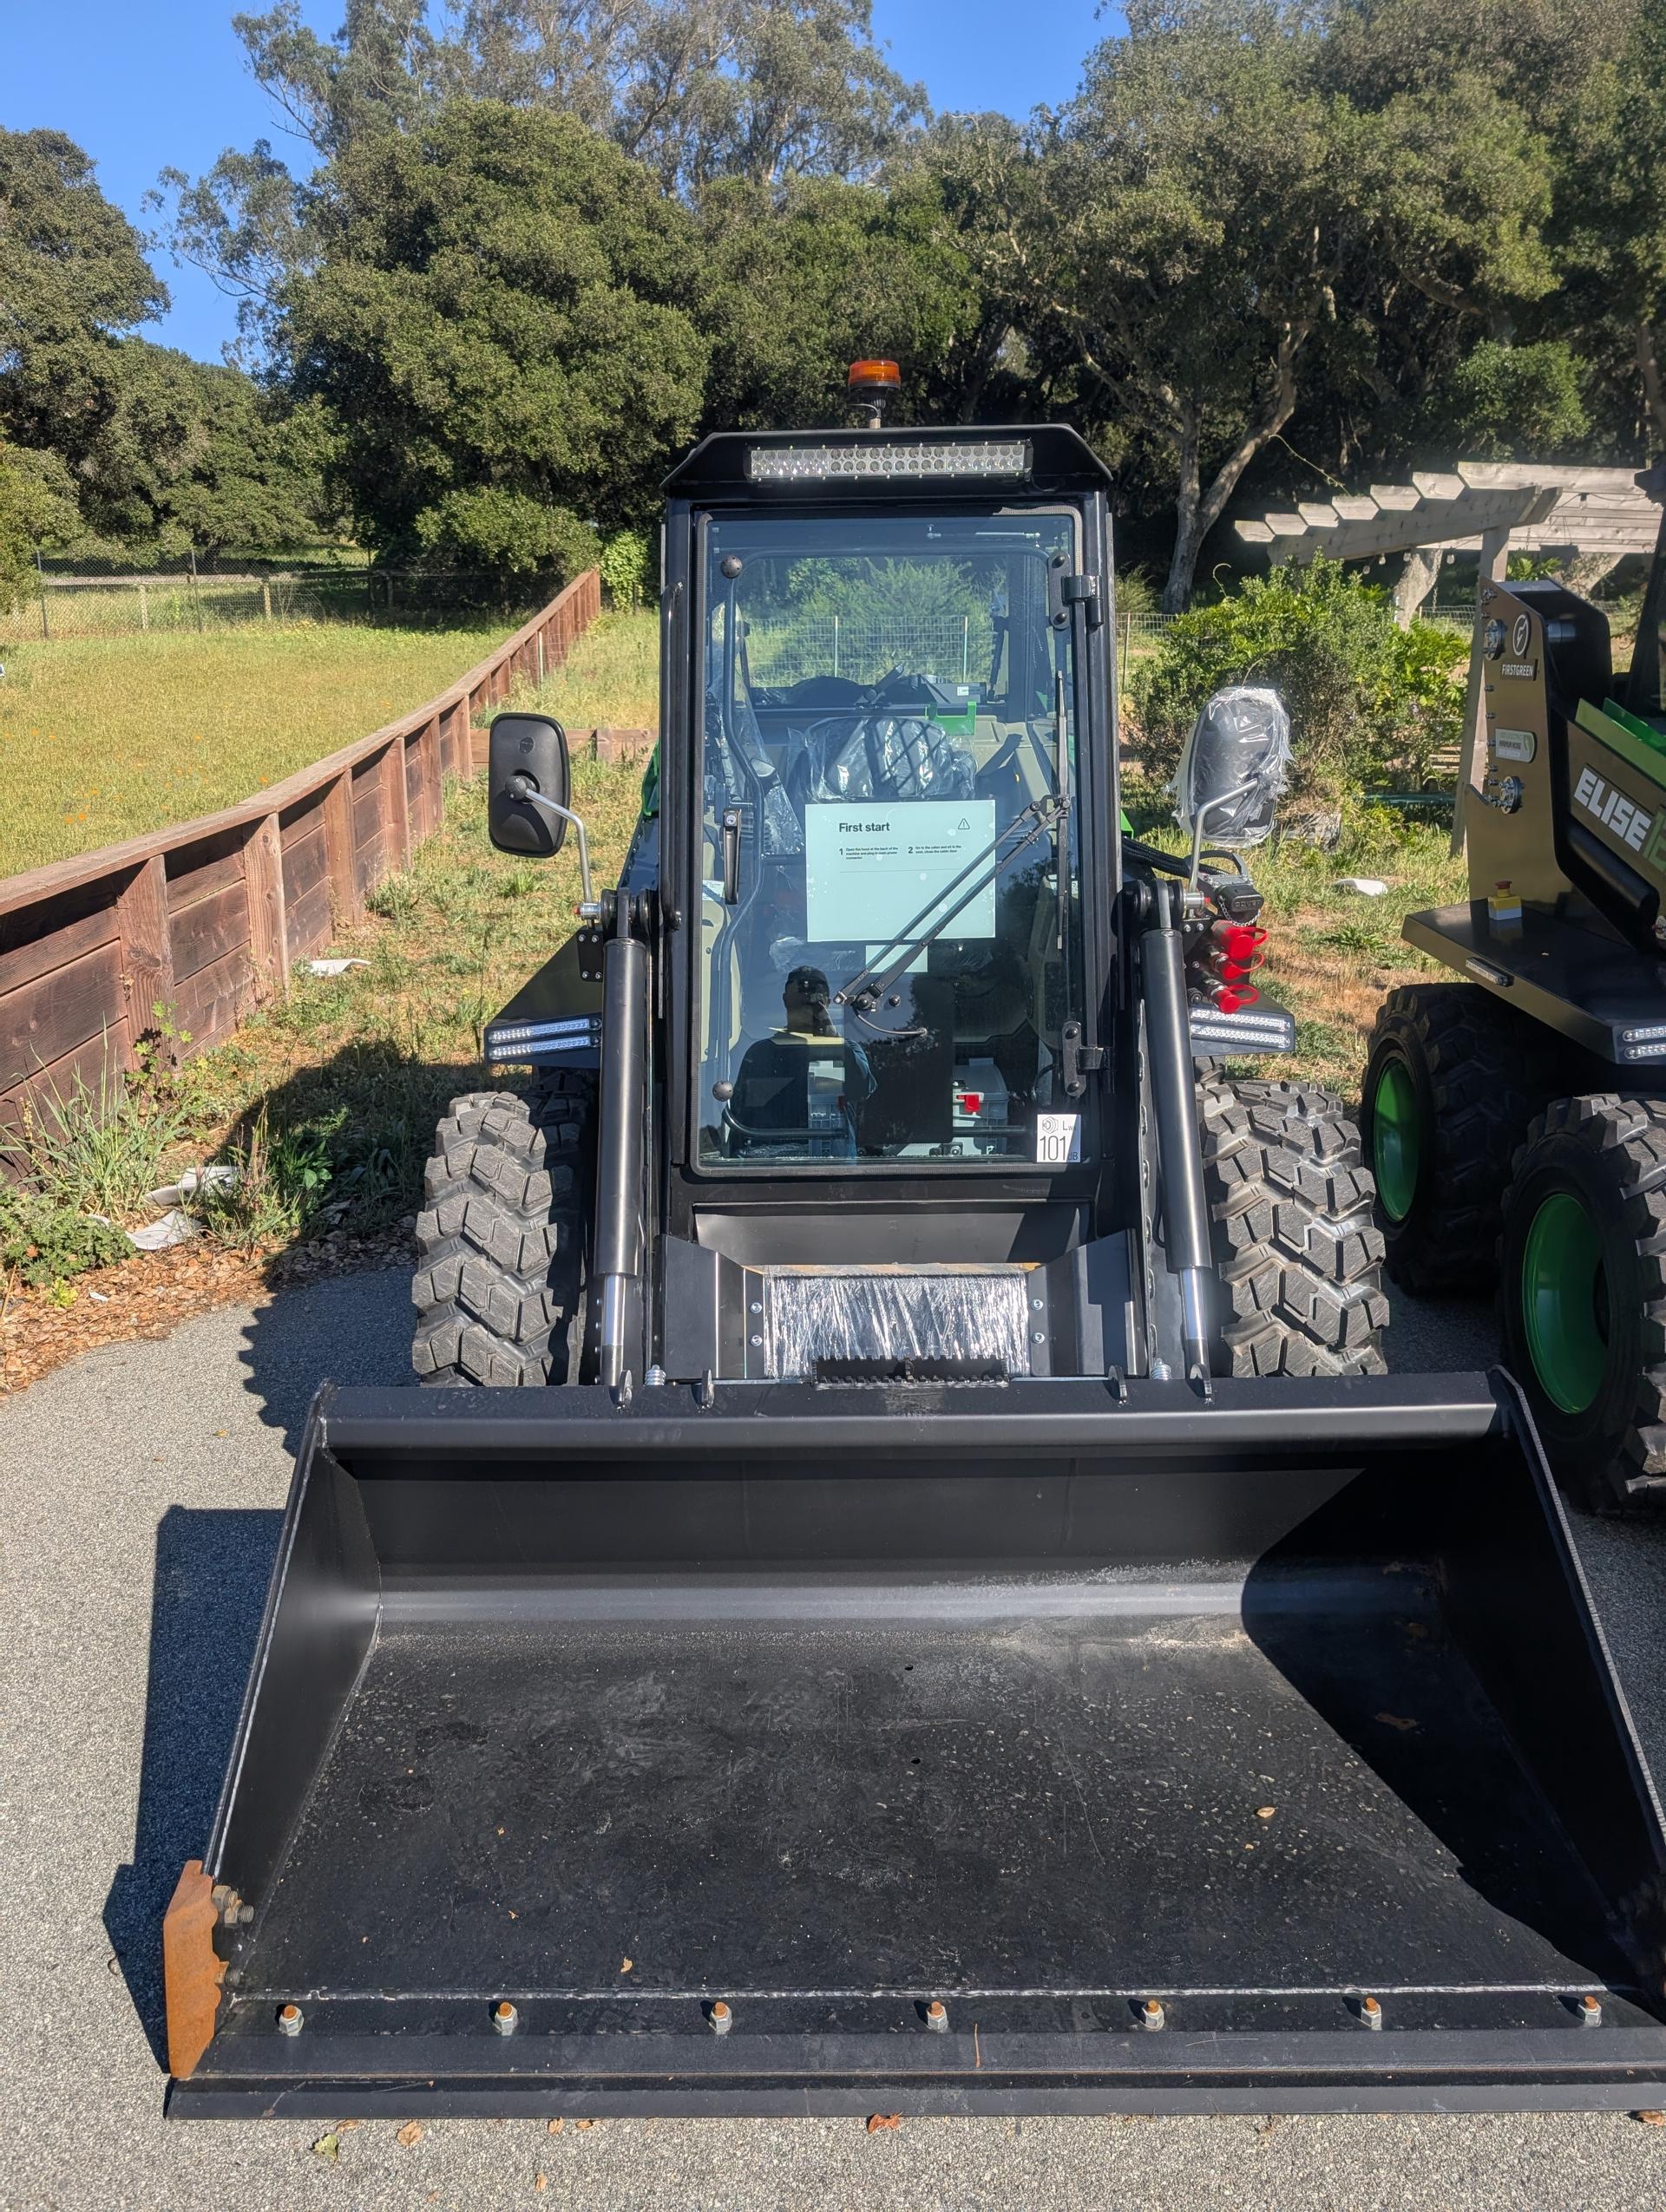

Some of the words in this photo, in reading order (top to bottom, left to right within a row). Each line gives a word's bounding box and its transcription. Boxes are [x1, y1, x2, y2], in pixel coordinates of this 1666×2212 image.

[1501, 664, 1533, 677] FIRSTGREEN
[1574, 768, 1651, 852] ELISE
[839, 822, 863, 832] First
[865, 821, 890, 832] start
[1040, 1135, 1066, 1161] 101
[1068, 1151, 1079, 1161] dB
